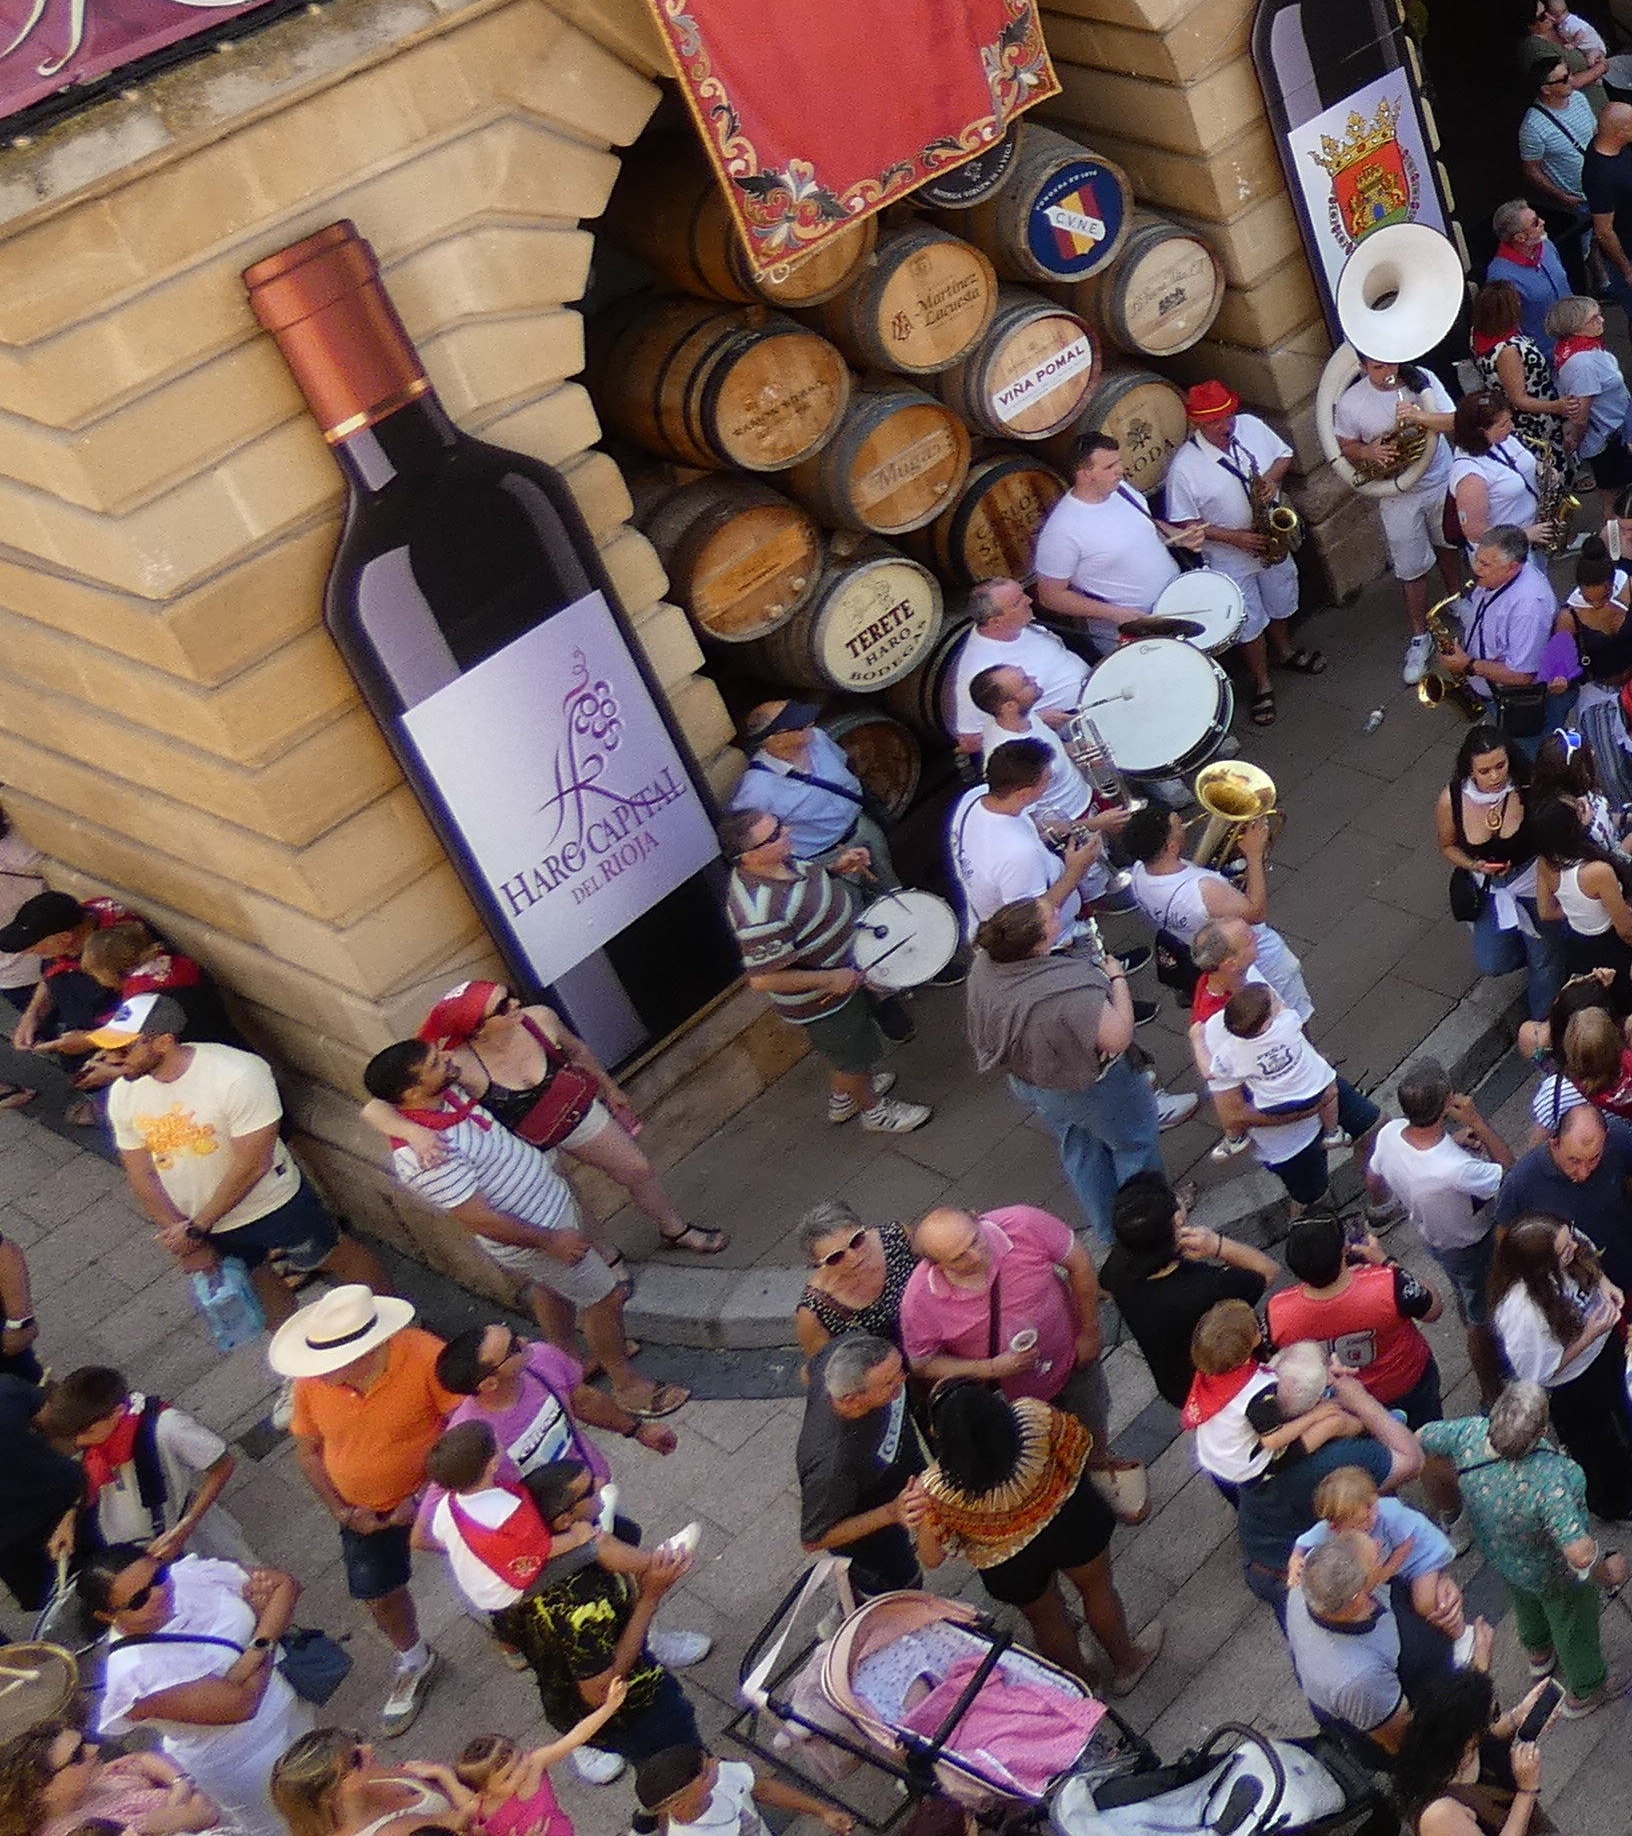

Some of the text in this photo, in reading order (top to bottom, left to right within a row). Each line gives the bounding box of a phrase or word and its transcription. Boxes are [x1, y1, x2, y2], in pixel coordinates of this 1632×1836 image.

[923, 287, 981, 327] Lacuesta
[998, 345, 1085, 407] VIÑA POMAL
[845, 599, 915, 660] TERETE
[849, 618, 927, 683] BODEGAS
[863, 627, 912, 666] HARO
[500, 766, 688, 919] HARO CAPITAL
[571, 832, 660, 906] DEL RIOJA
